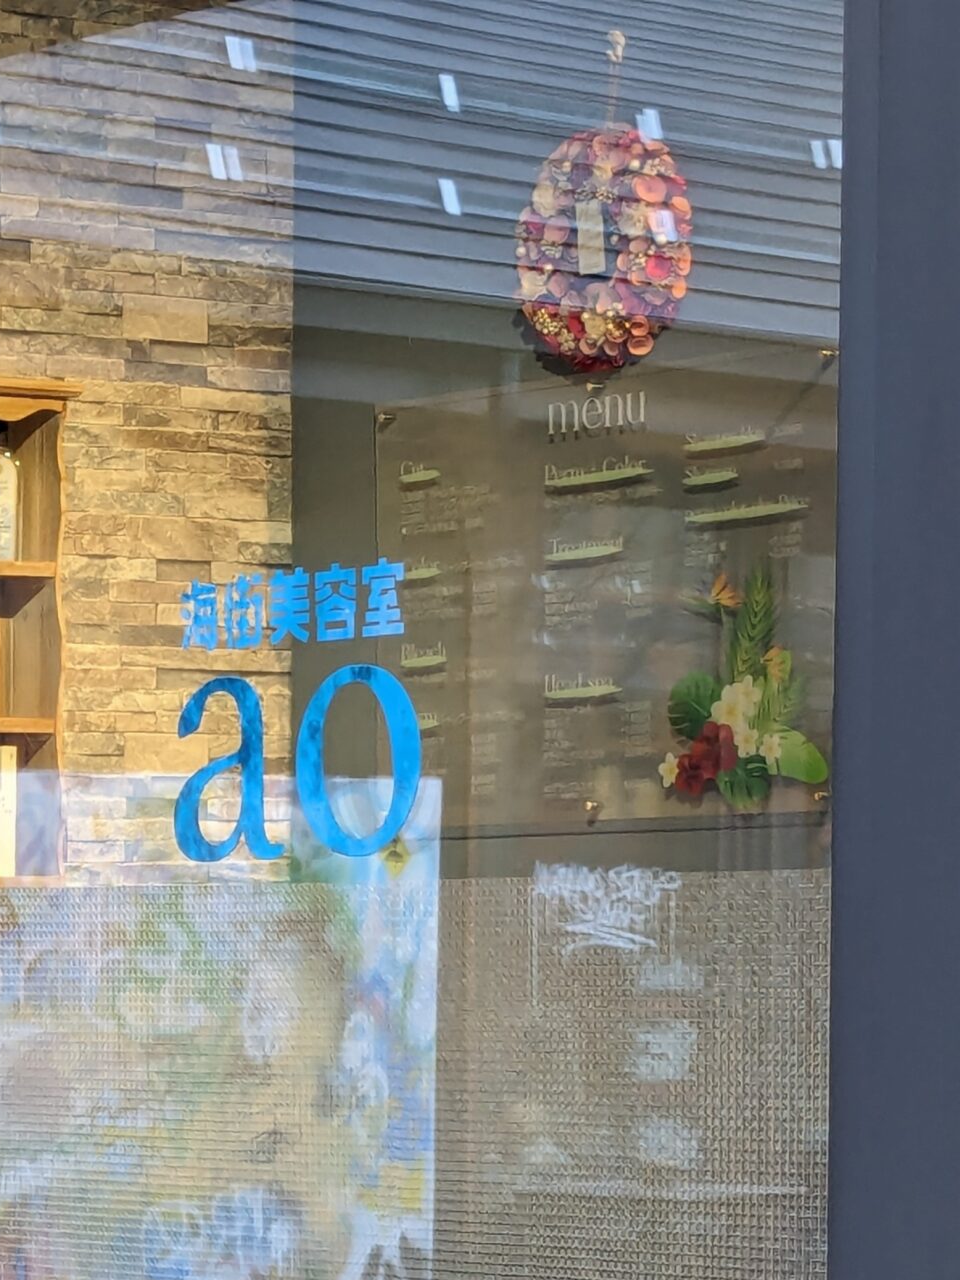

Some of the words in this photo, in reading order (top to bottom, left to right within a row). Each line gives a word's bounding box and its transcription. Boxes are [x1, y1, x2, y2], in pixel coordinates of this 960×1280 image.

[548, 391, 646, 435] menu
[180, 557, 405, 652] 海街美容室
[173, 663, 422, 862] ao
